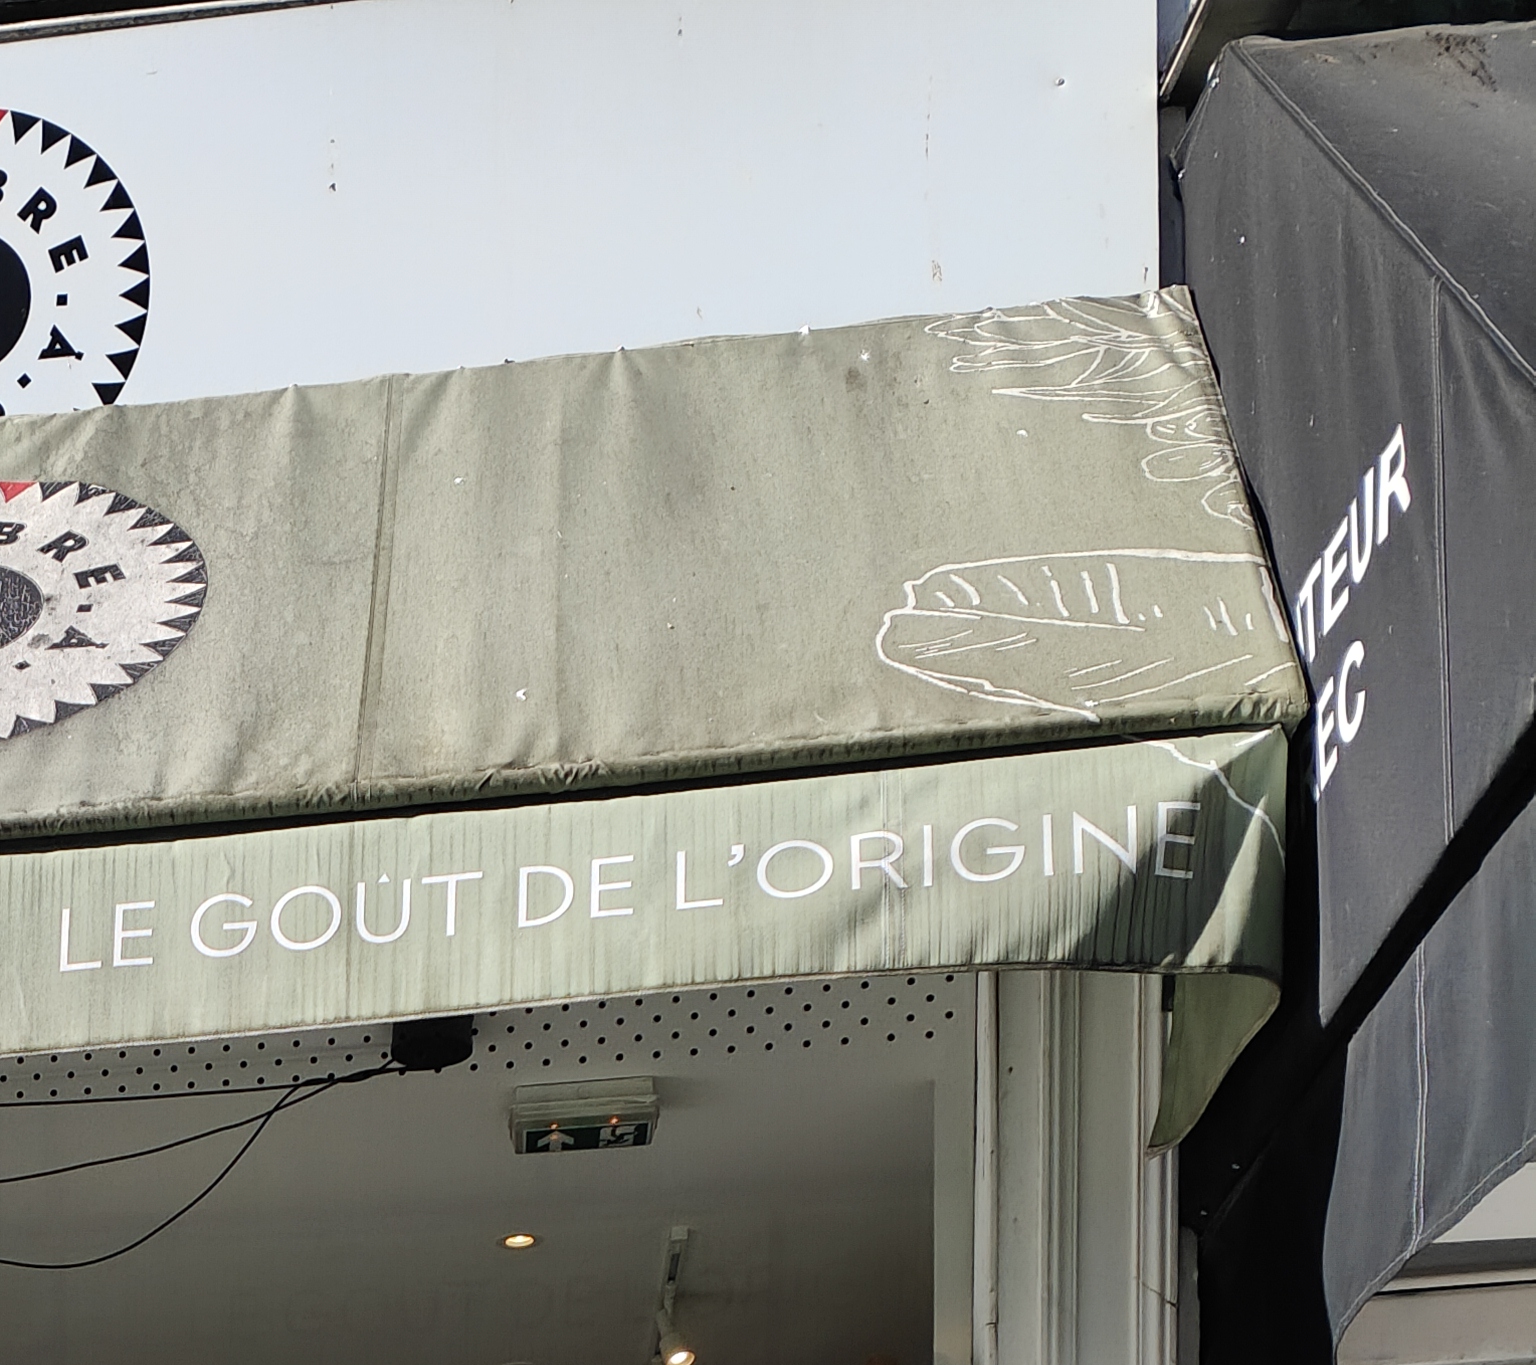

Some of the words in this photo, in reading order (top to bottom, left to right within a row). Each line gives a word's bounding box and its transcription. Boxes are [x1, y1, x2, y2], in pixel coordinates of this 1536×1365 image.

[58, 899, 156, 973] LE
[189, 870, 484, 958] GOÛT
[517, 853, 635, 929] DE
[674, 800, 1203, 912] L'ORIGINE
